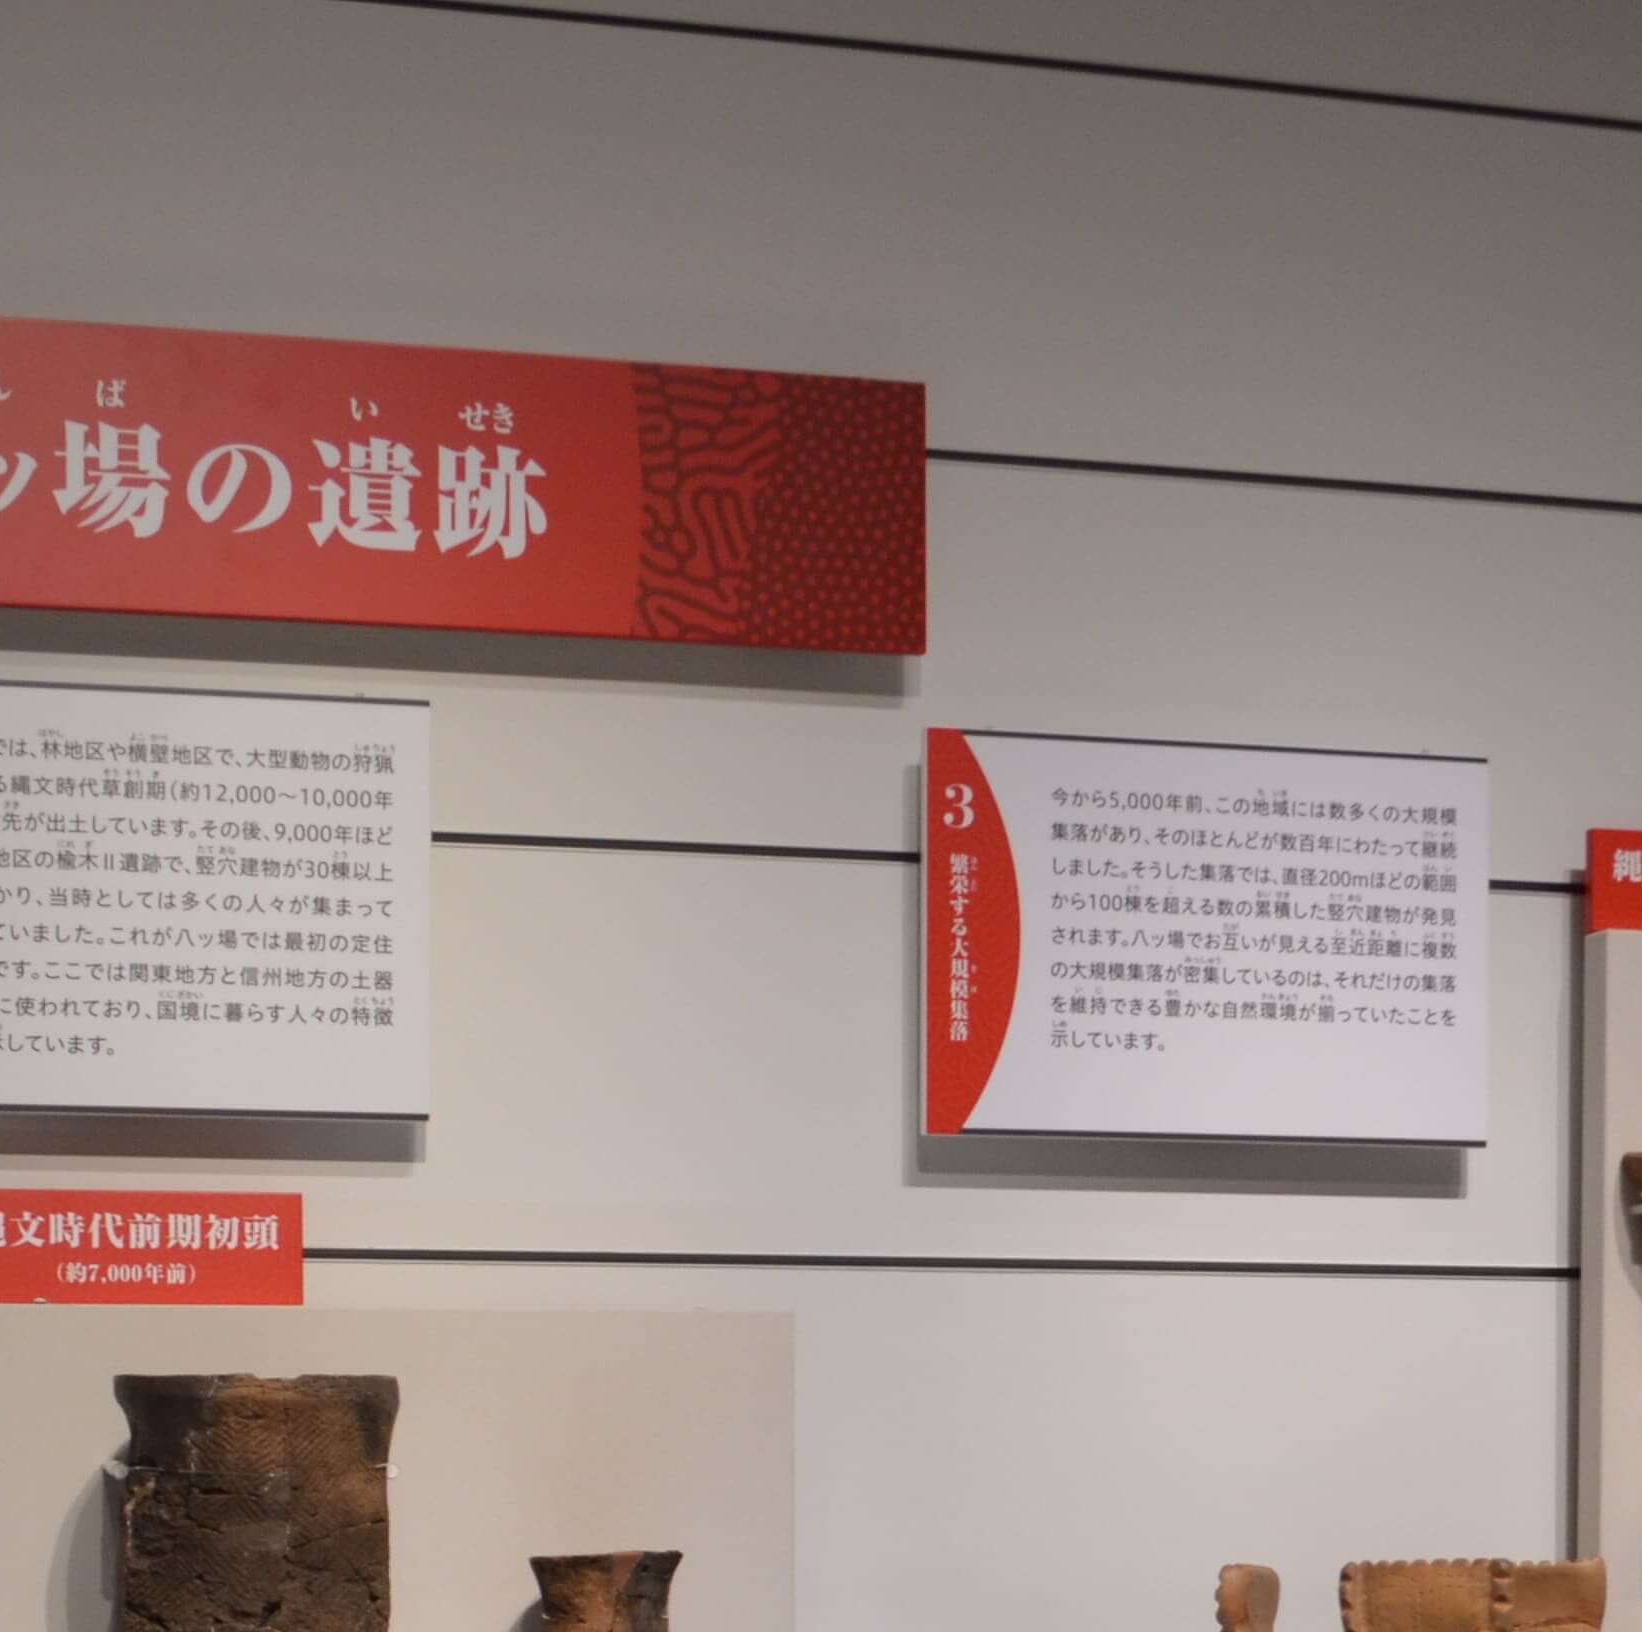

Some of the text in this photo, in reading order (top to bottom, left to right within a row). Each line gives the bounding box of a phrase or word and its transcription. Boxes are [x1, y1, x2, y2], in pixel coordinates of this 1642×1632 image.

[96, 379, 126, 408] ば
[351, 397, 379, 421] い
[458, 402, 514, 435] せき
[943, 783, 975, 829] 3
[949, 853, 969, 1041] 繁栄する大規模集落
[1051, 1030, 1165, 1052] 示しています。
